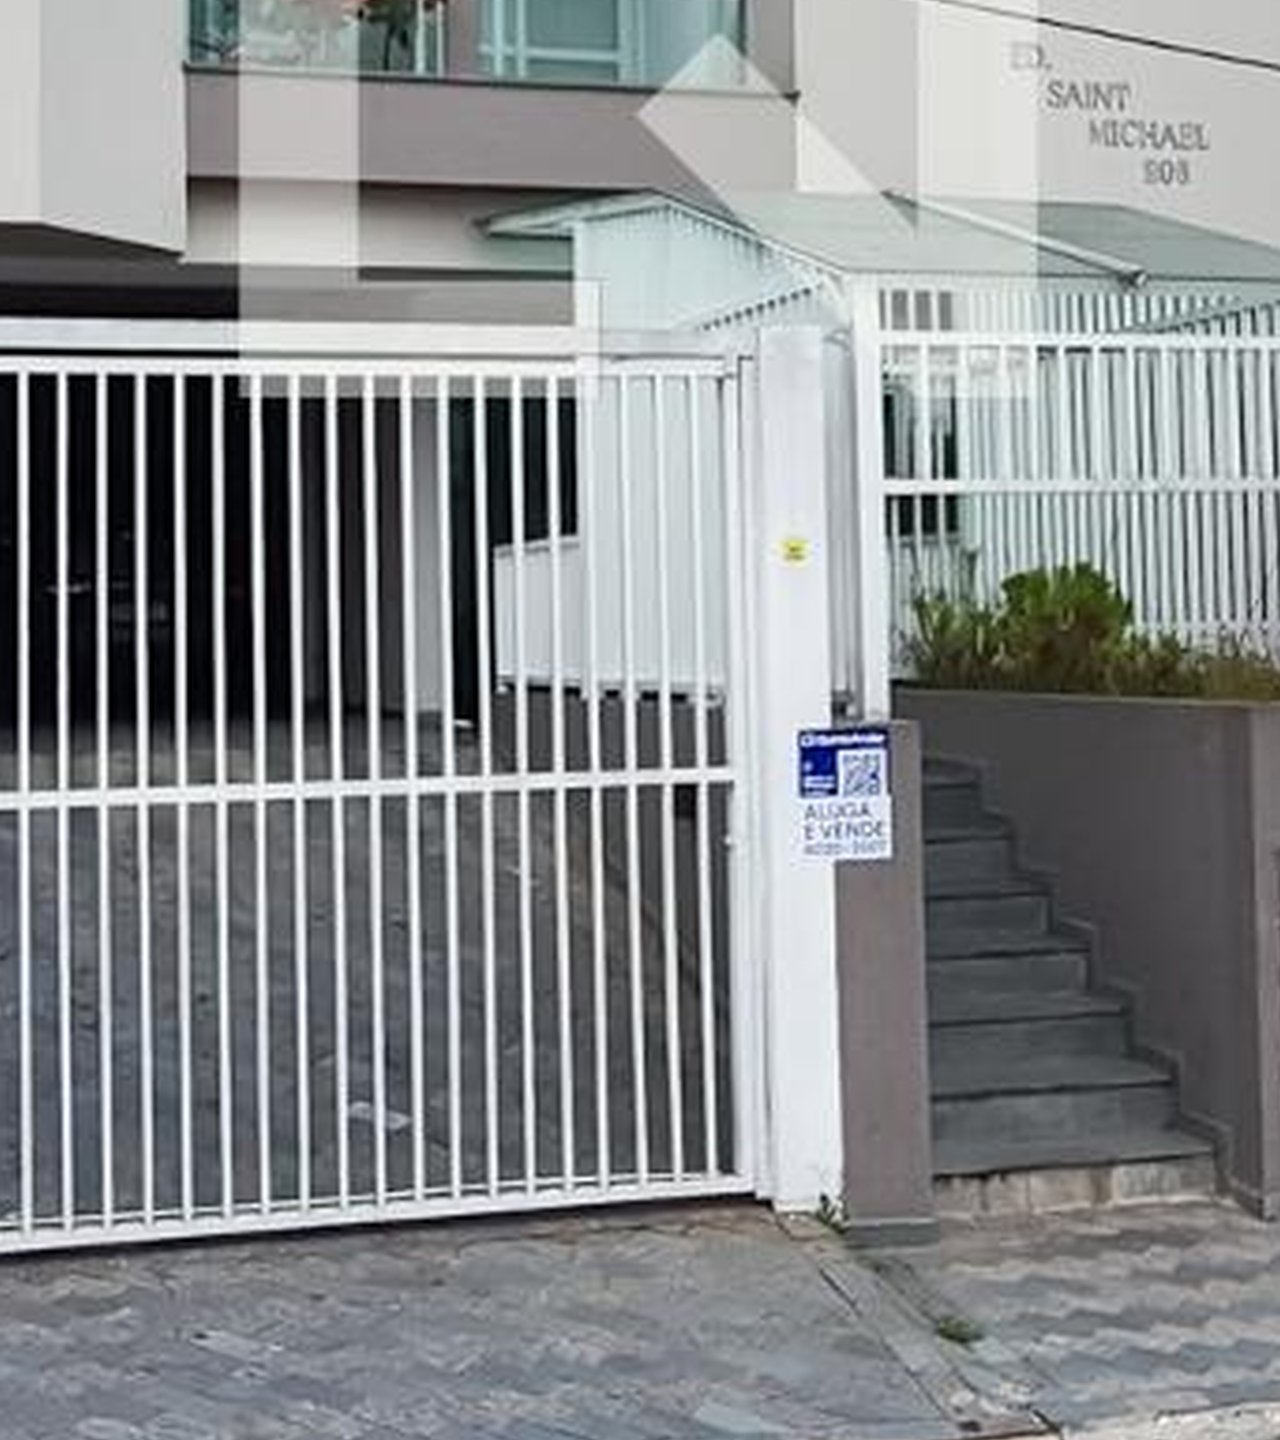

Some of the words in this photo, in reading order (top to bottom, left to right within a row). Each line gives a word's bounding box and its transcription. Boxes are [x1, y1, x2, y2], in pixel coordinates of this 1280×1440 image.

[1045, 78, 1132, 111] SAINT
[1088, 119, 1211, 151] MICHAEL
[804, 803, 872, 820] ALUGA
[819, 821, 883, 839] VENDE
